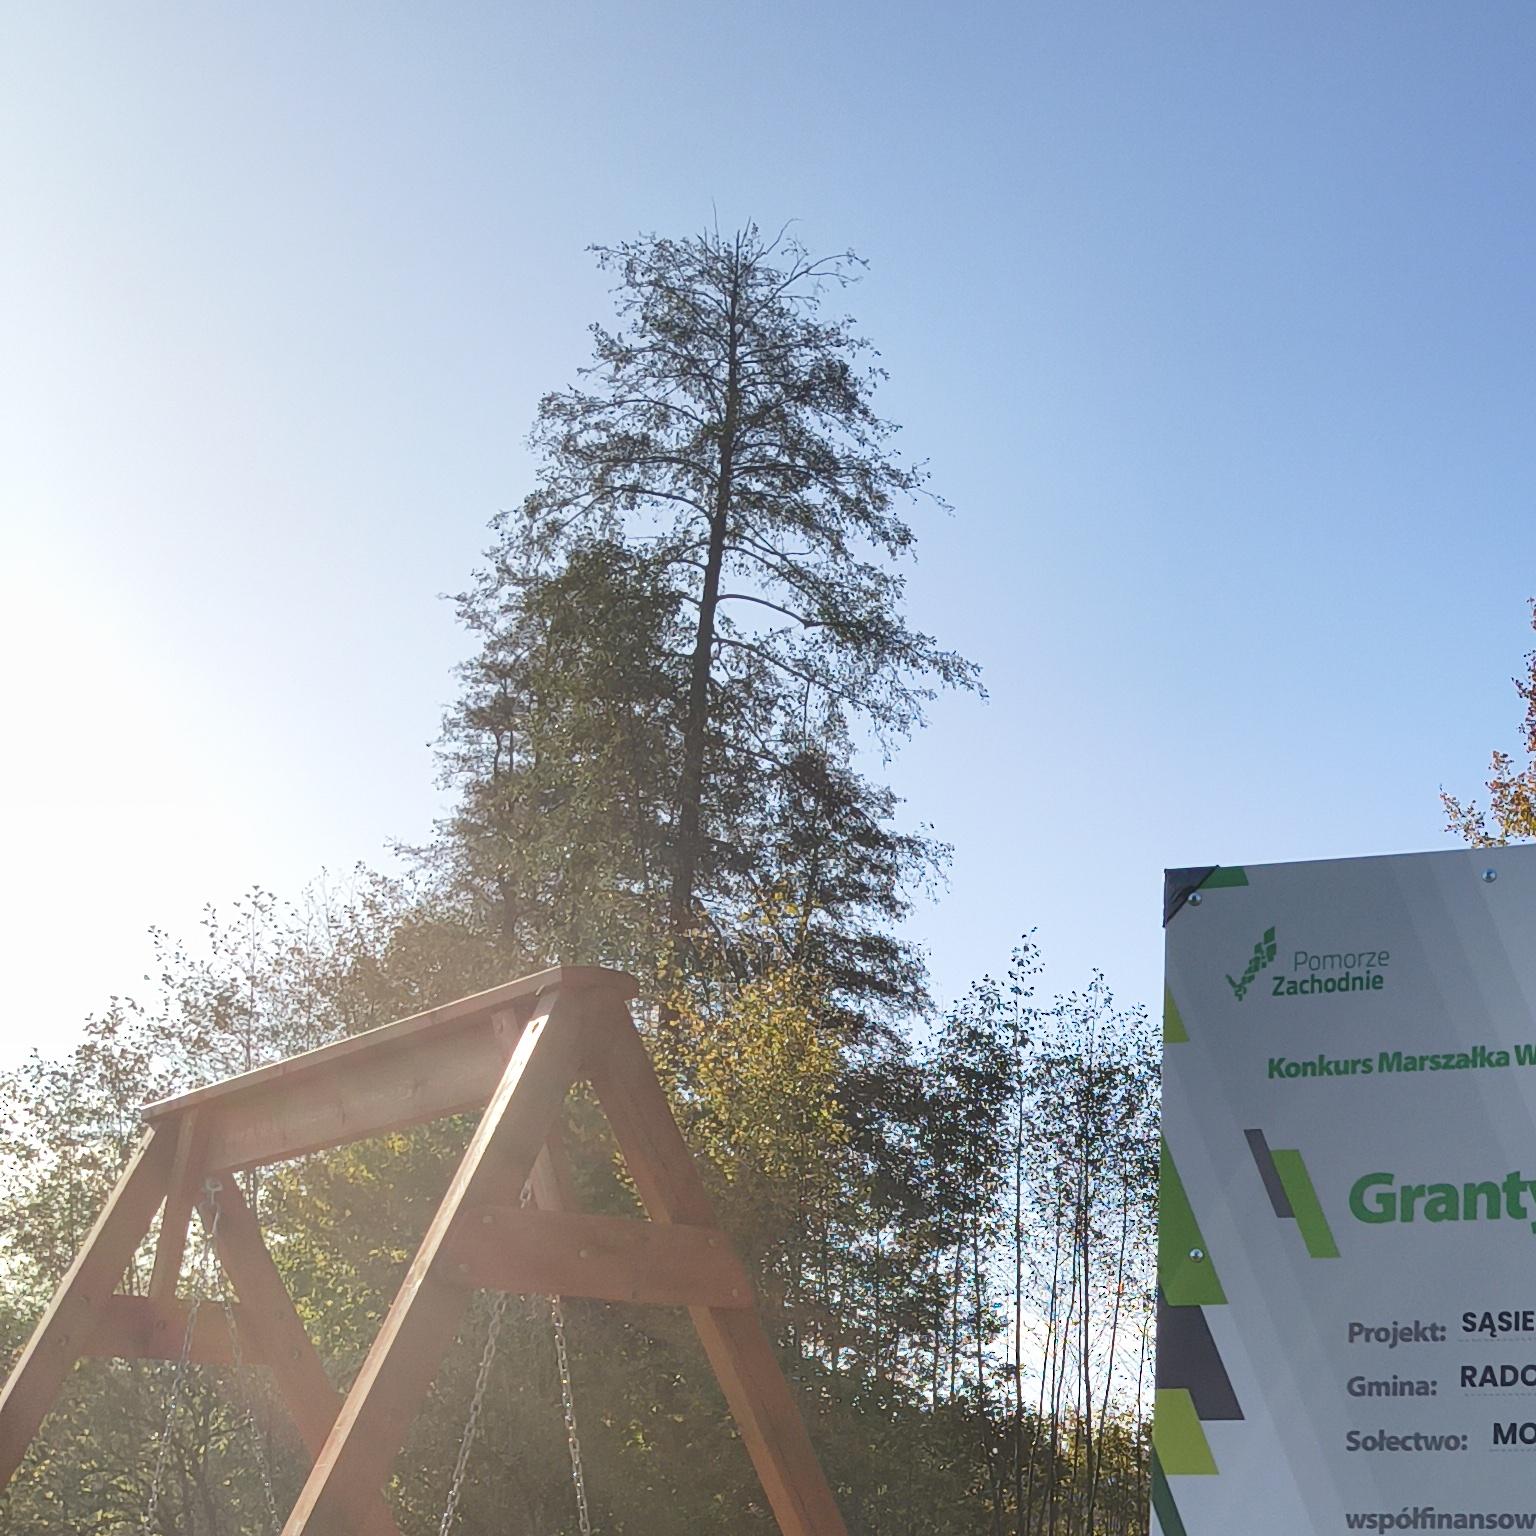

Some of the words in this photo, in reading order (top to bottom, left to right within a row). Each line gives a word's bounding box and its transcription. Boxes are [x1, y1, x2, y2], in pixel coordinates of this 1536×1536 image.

[1294, 948, 1390, 972] Pomorze
[1271, 970, 1384, 996] Zachodnie
[1269, 1055, 1373, 1078] Konkurs
[1378, 1046, 1510, 1072] Marszałka
[1349, 1320, 1446, 1349] Projekt:
[1347, 1375, 1437, 1396] Gmina:
[1346, 1430, 1467, 1451] Sołectwo:
